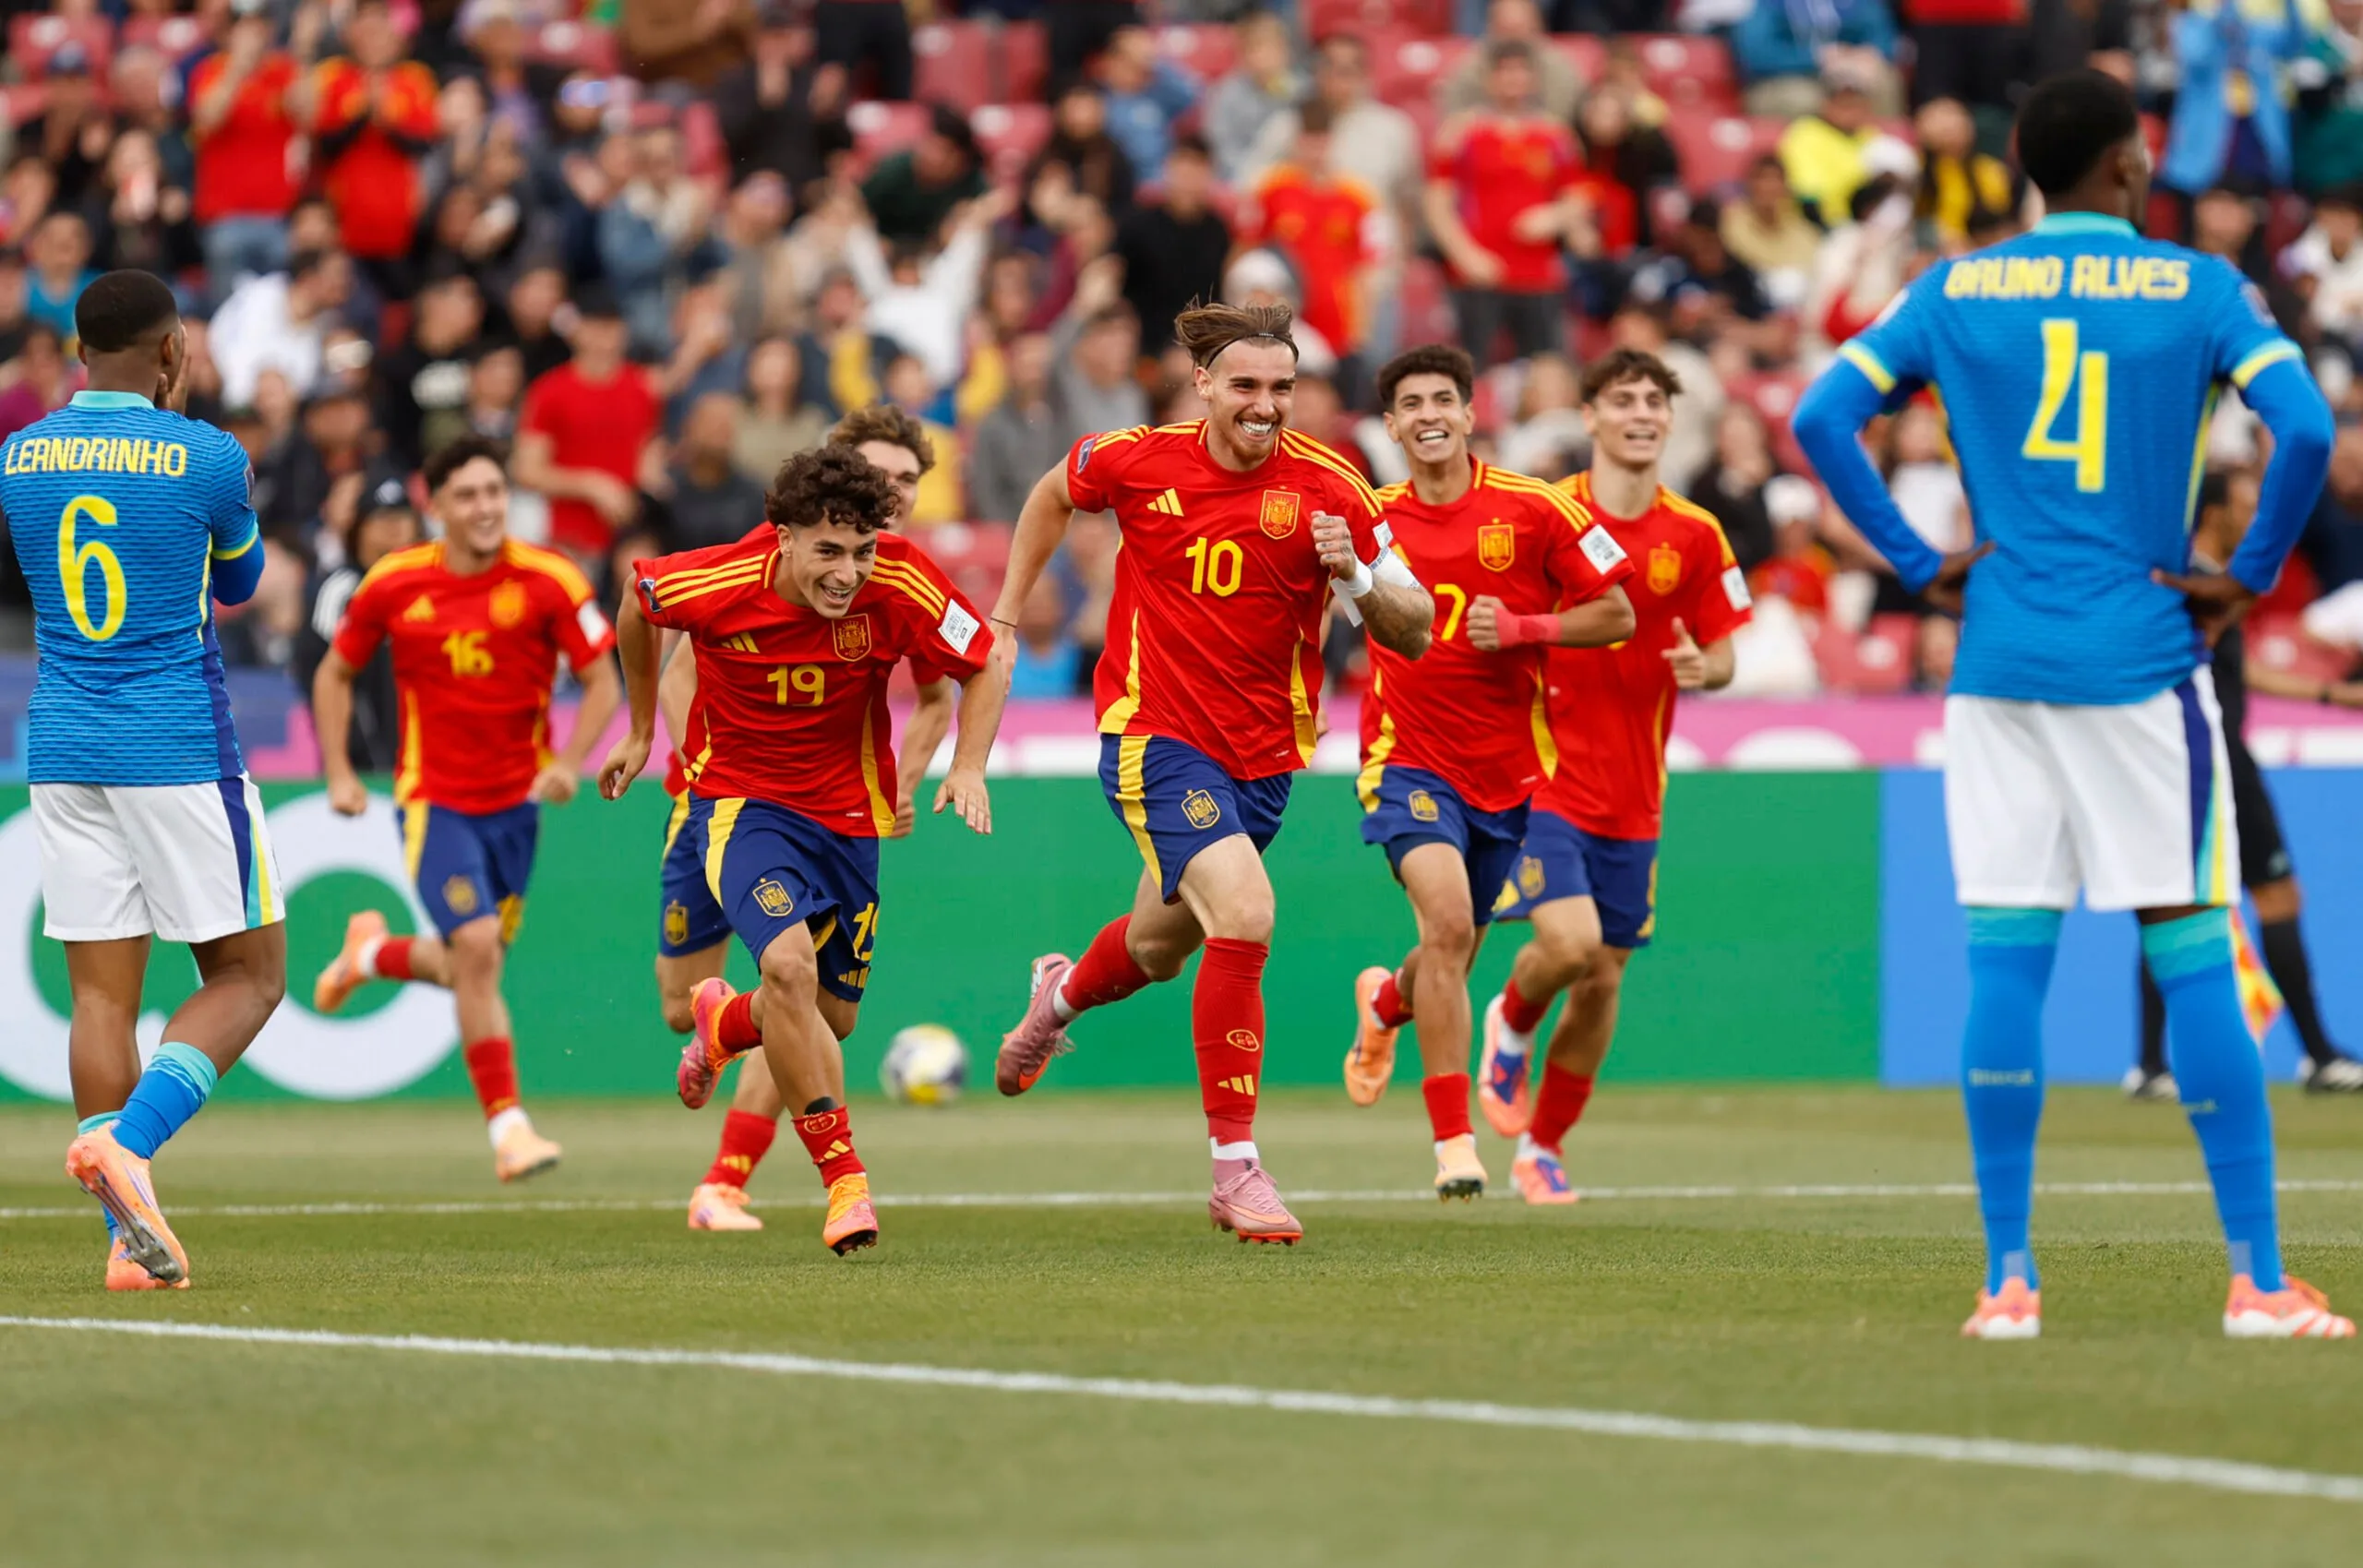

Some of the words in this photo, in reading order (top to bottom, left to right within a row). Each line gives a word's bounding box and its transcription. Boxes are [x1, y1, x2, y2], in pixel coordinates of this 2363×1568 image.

[1944, 256, 2064, 300] BRUNO
[2069, 255, 2190, 300] ALVES
[2021, 317, 2109, 493] 4
[5, 437, 187, 477] LEANDRINHO
[58, 495, 127, 641] 6
[1185, 536, 1243, 597] 10
[1433, 583, 1467, 641] 7
[440, 630, 495, 678] 16
[767, 664, 825, 708] 19
